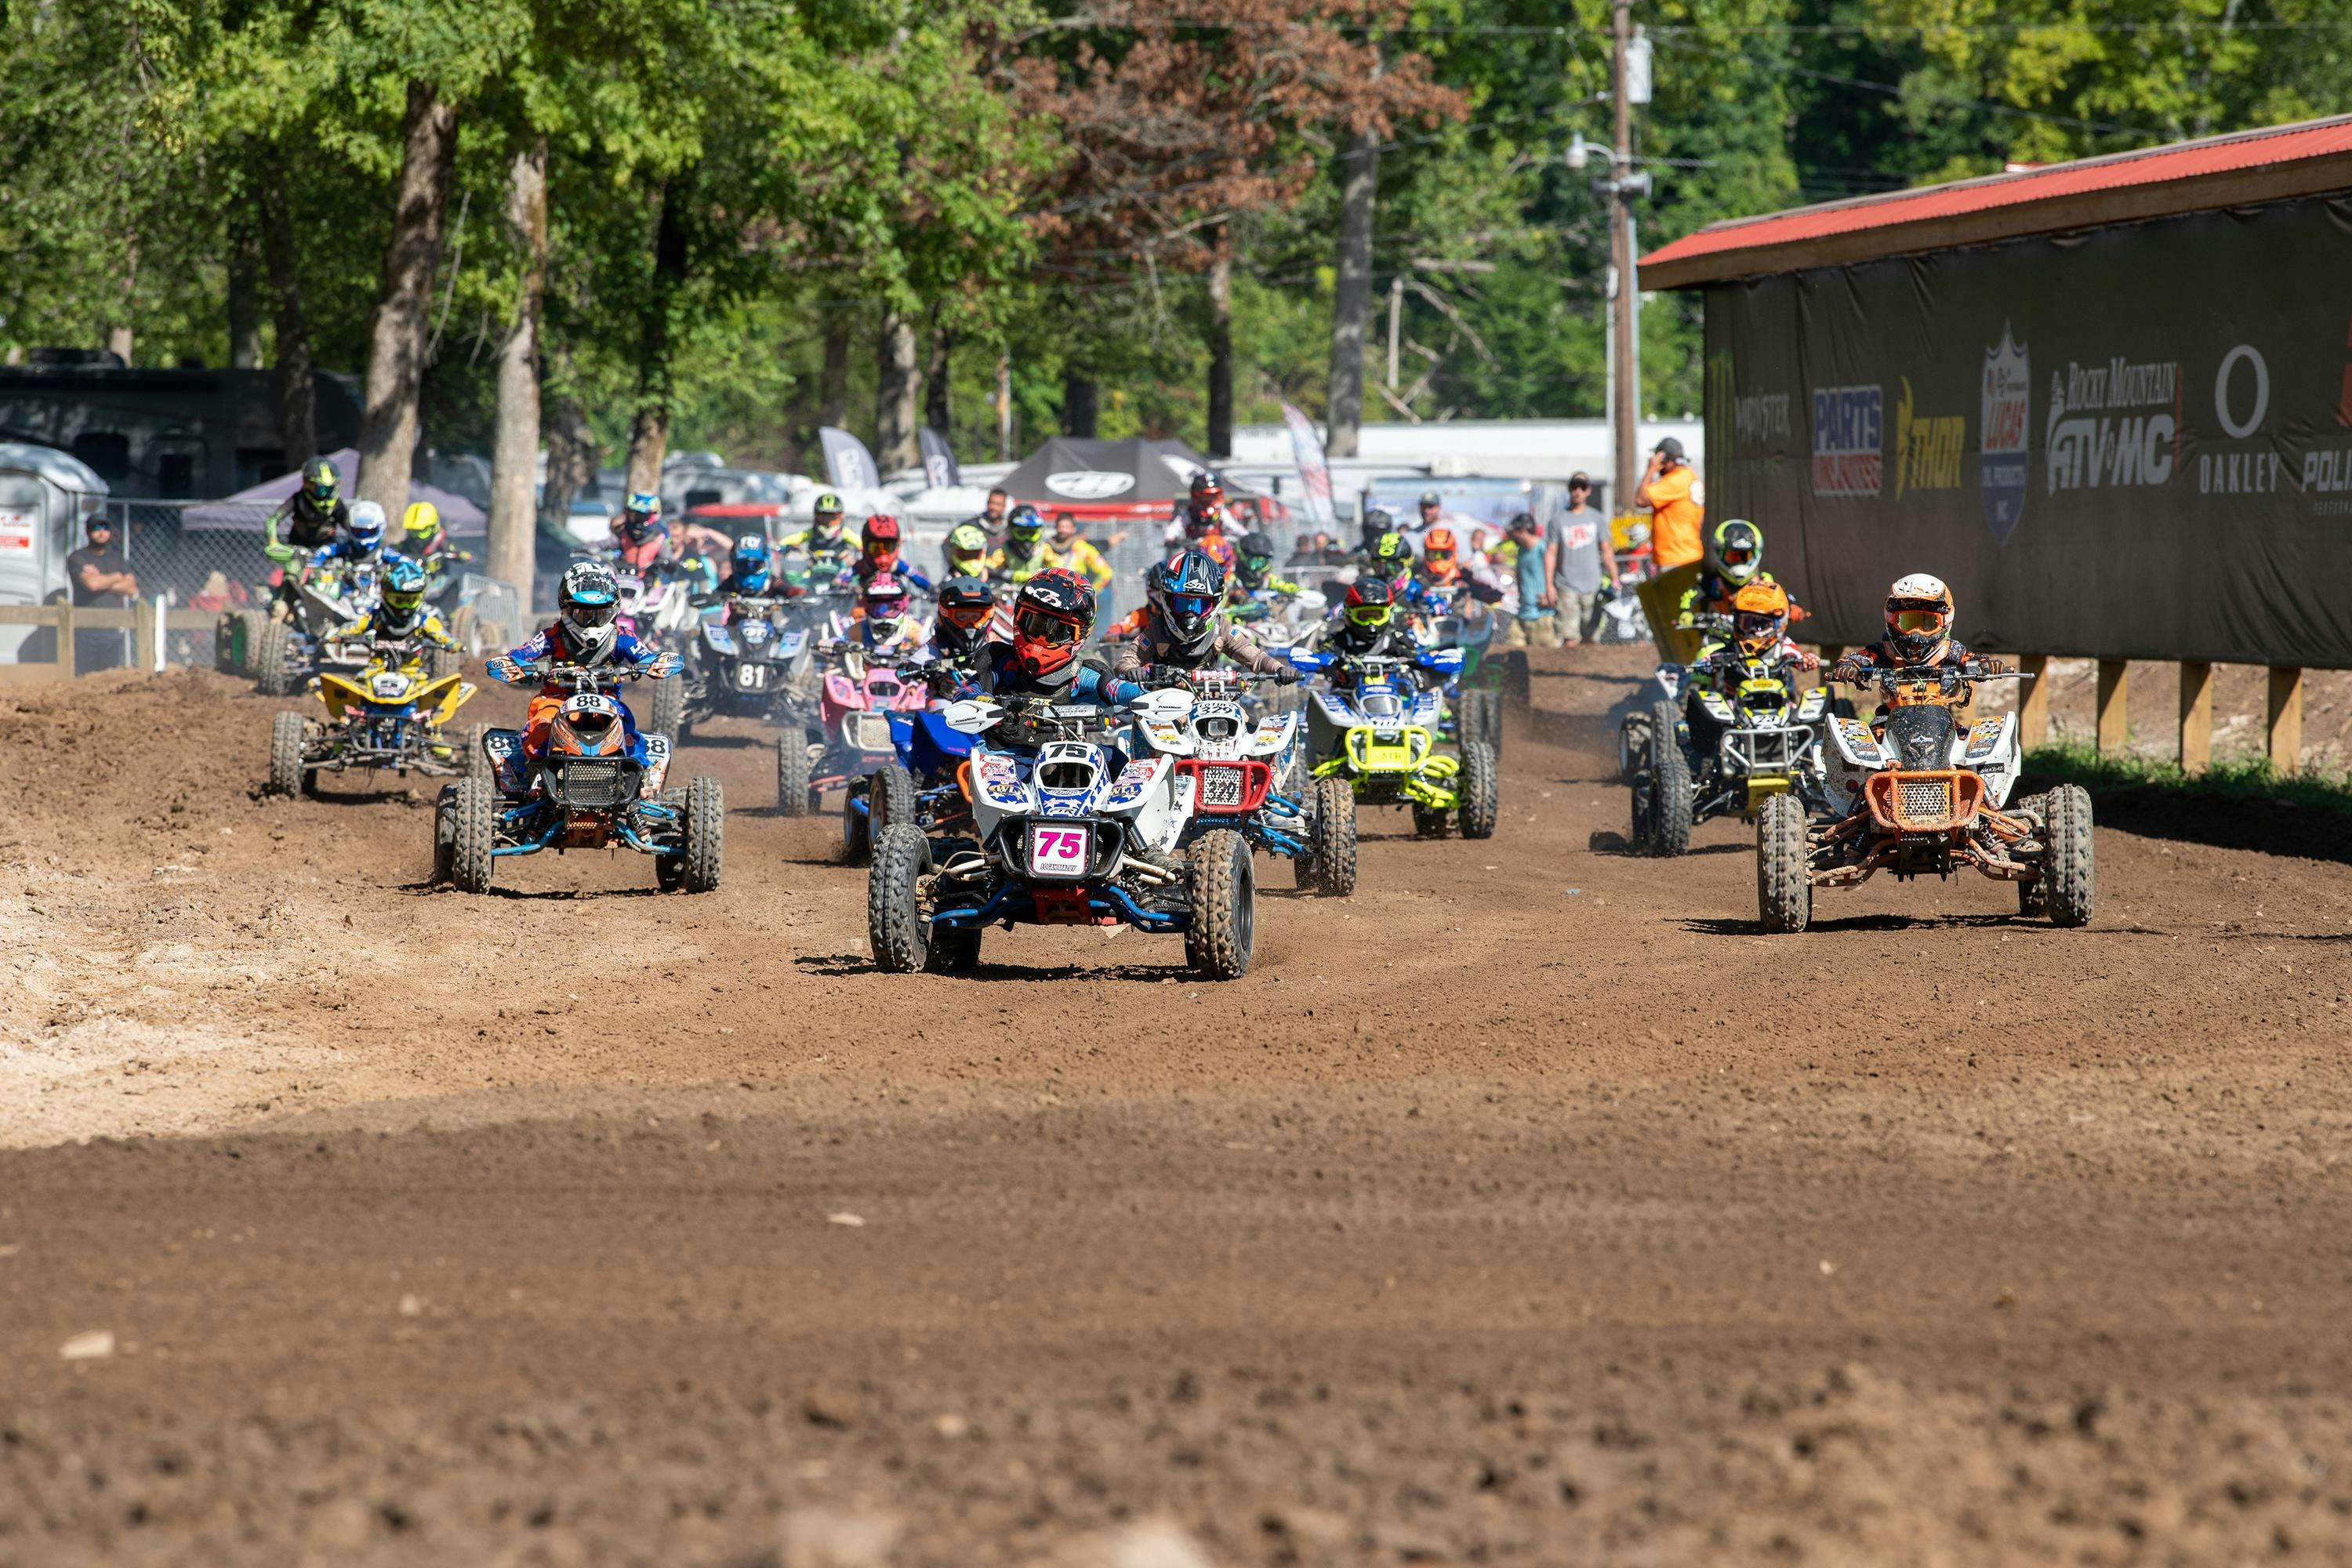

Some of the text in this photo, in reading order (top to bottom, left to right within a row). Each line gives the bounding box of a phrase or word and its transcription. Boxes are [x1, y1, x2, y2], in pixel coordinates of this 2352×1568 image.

[1813, 388, 1882, 453] PARTS
[1911, 416, 1965, 489] THOR
[2199, 452, 2281, 494] OAKLEY
[739, 664, 765, 688] 81
[576, 695, 601, 707] 88
[1201, 706, 1233, 716] 329
[1049, 743, 1088, 758] 75
[1038, 831, 1082, 858] 75
[1040, 862, 1058, 872] LOGAN
